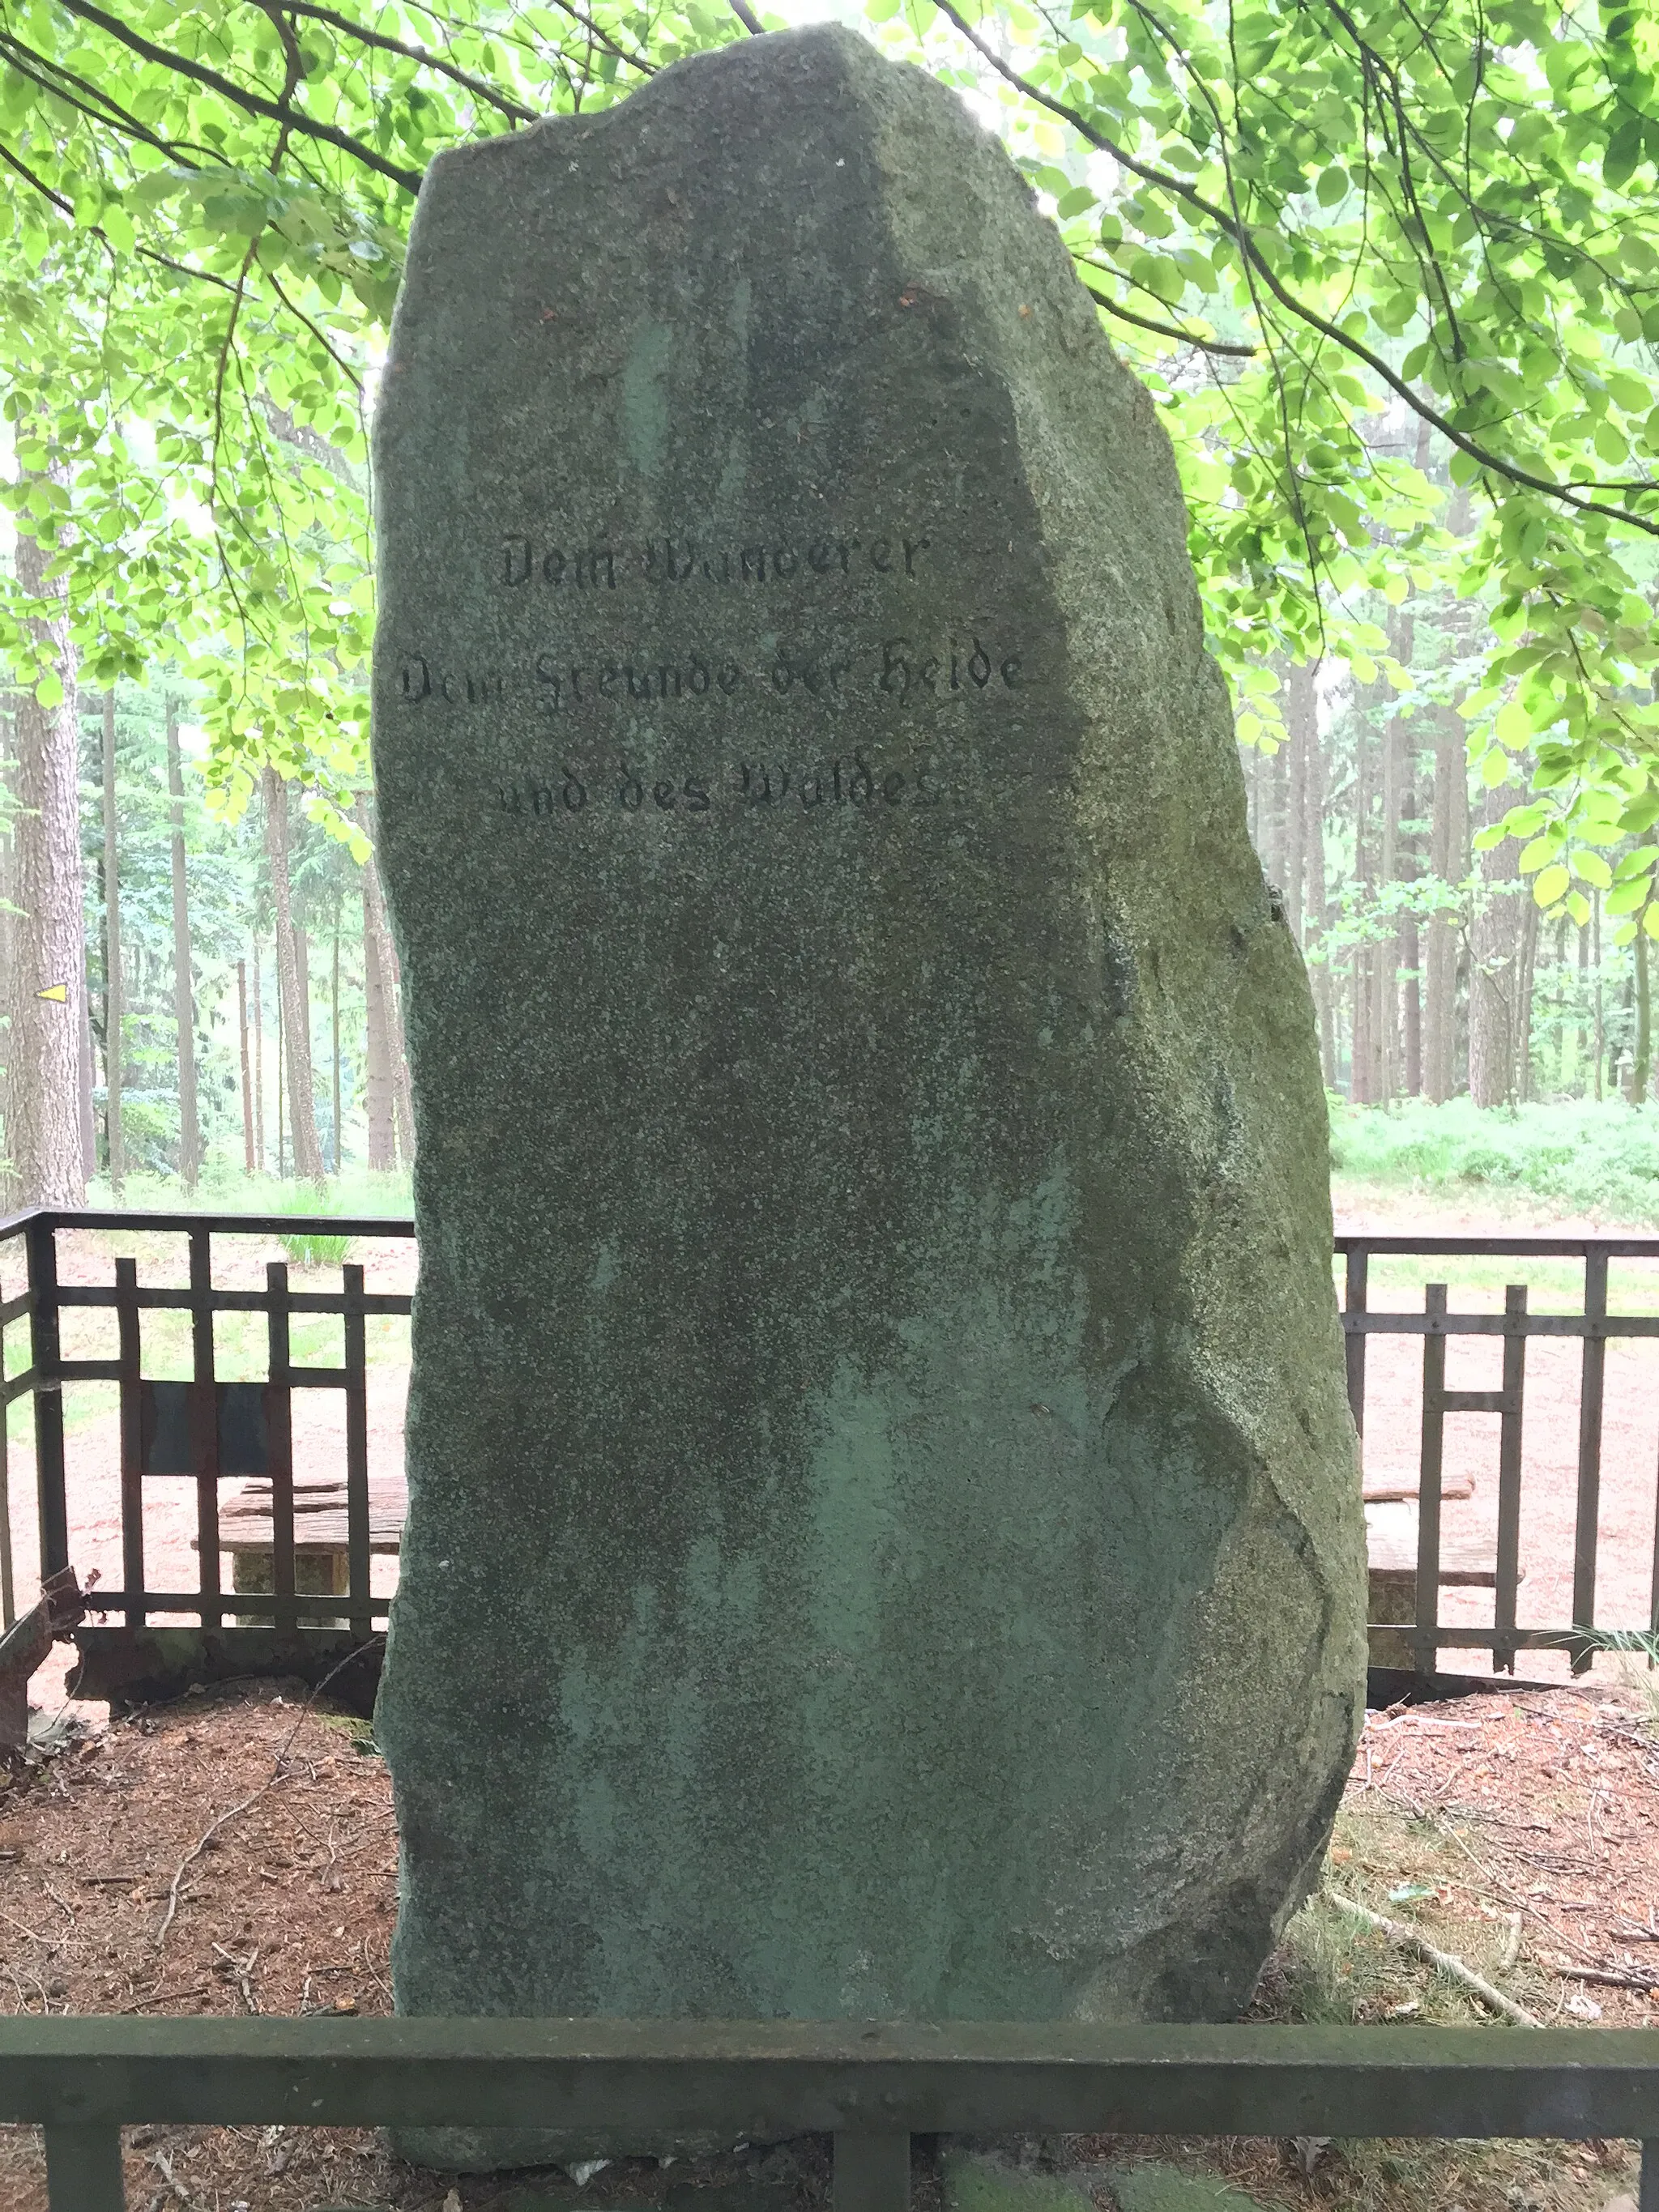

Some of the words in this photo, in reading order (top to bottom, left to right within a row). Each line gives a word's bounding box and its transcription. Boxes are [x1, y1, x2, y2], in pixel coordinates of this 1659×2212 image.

[501, 533, 616, 590] Dem
[644, 535, 932, 583] Wanderer
[535, 651, 742, 716] Freunde
[770, 646, 851, 697] der
[881, 635, 1023, 710] Heide
[497, 764, 588, 816] und
[619, 759, 711, 811] des
